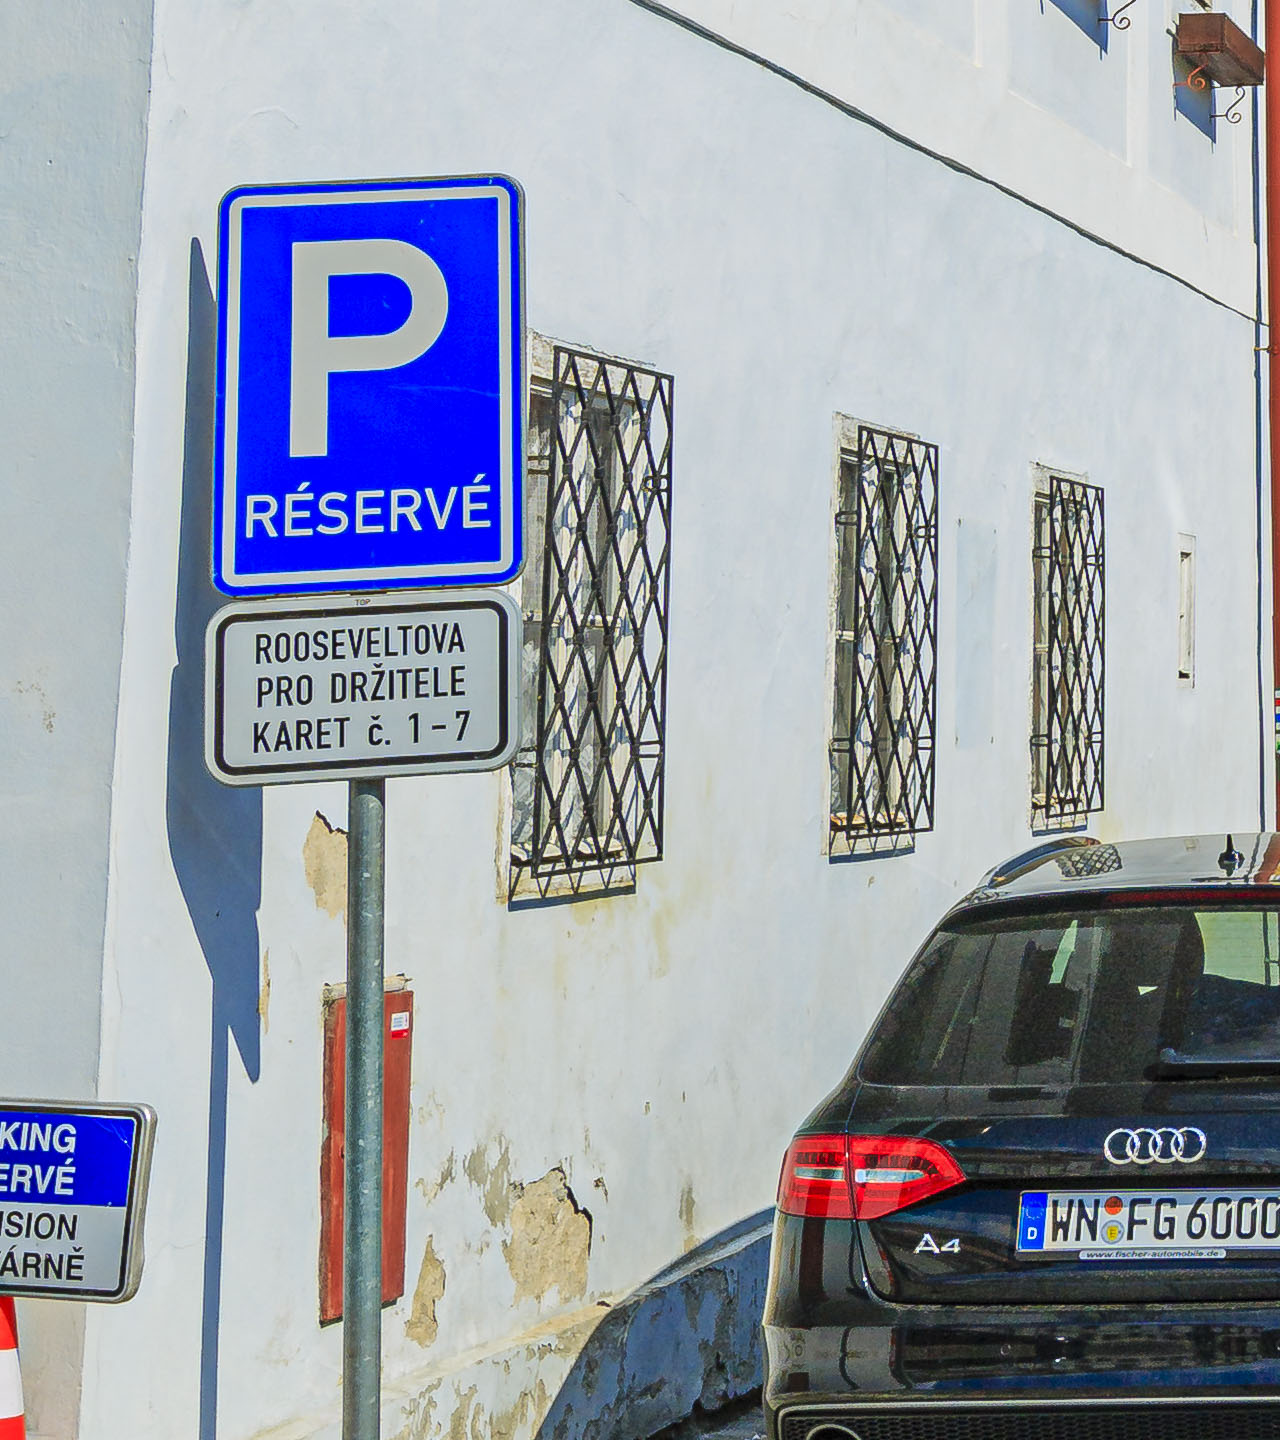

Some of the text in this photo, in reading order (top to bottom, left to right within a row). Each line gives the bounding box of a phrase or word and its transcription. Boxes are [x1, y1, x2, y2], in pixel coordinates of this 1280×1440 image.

[289, 239, 449, 458] P
[245, 473, 492, 539] RÉSERVÉ
[255, 623, 465, 665] ROOSEVELTOVA
[256, 663, 466, 708] PRO DRŽITELE
[252, 717, 351, 754] KARET
[368, 715, 391, 746] č.
[0, 1121, 77, 1153] KING
[0, 1211, 78, 1240] SION
[1027, 1227, 1038, 1240] D
[1051, 1198, 1100, 1242] WN
[1127, 1197, 1178, 1241] FG
[0, 1244, 85, 1281] ÁRNĚ
[913, 1232, 961, 1254] A4
